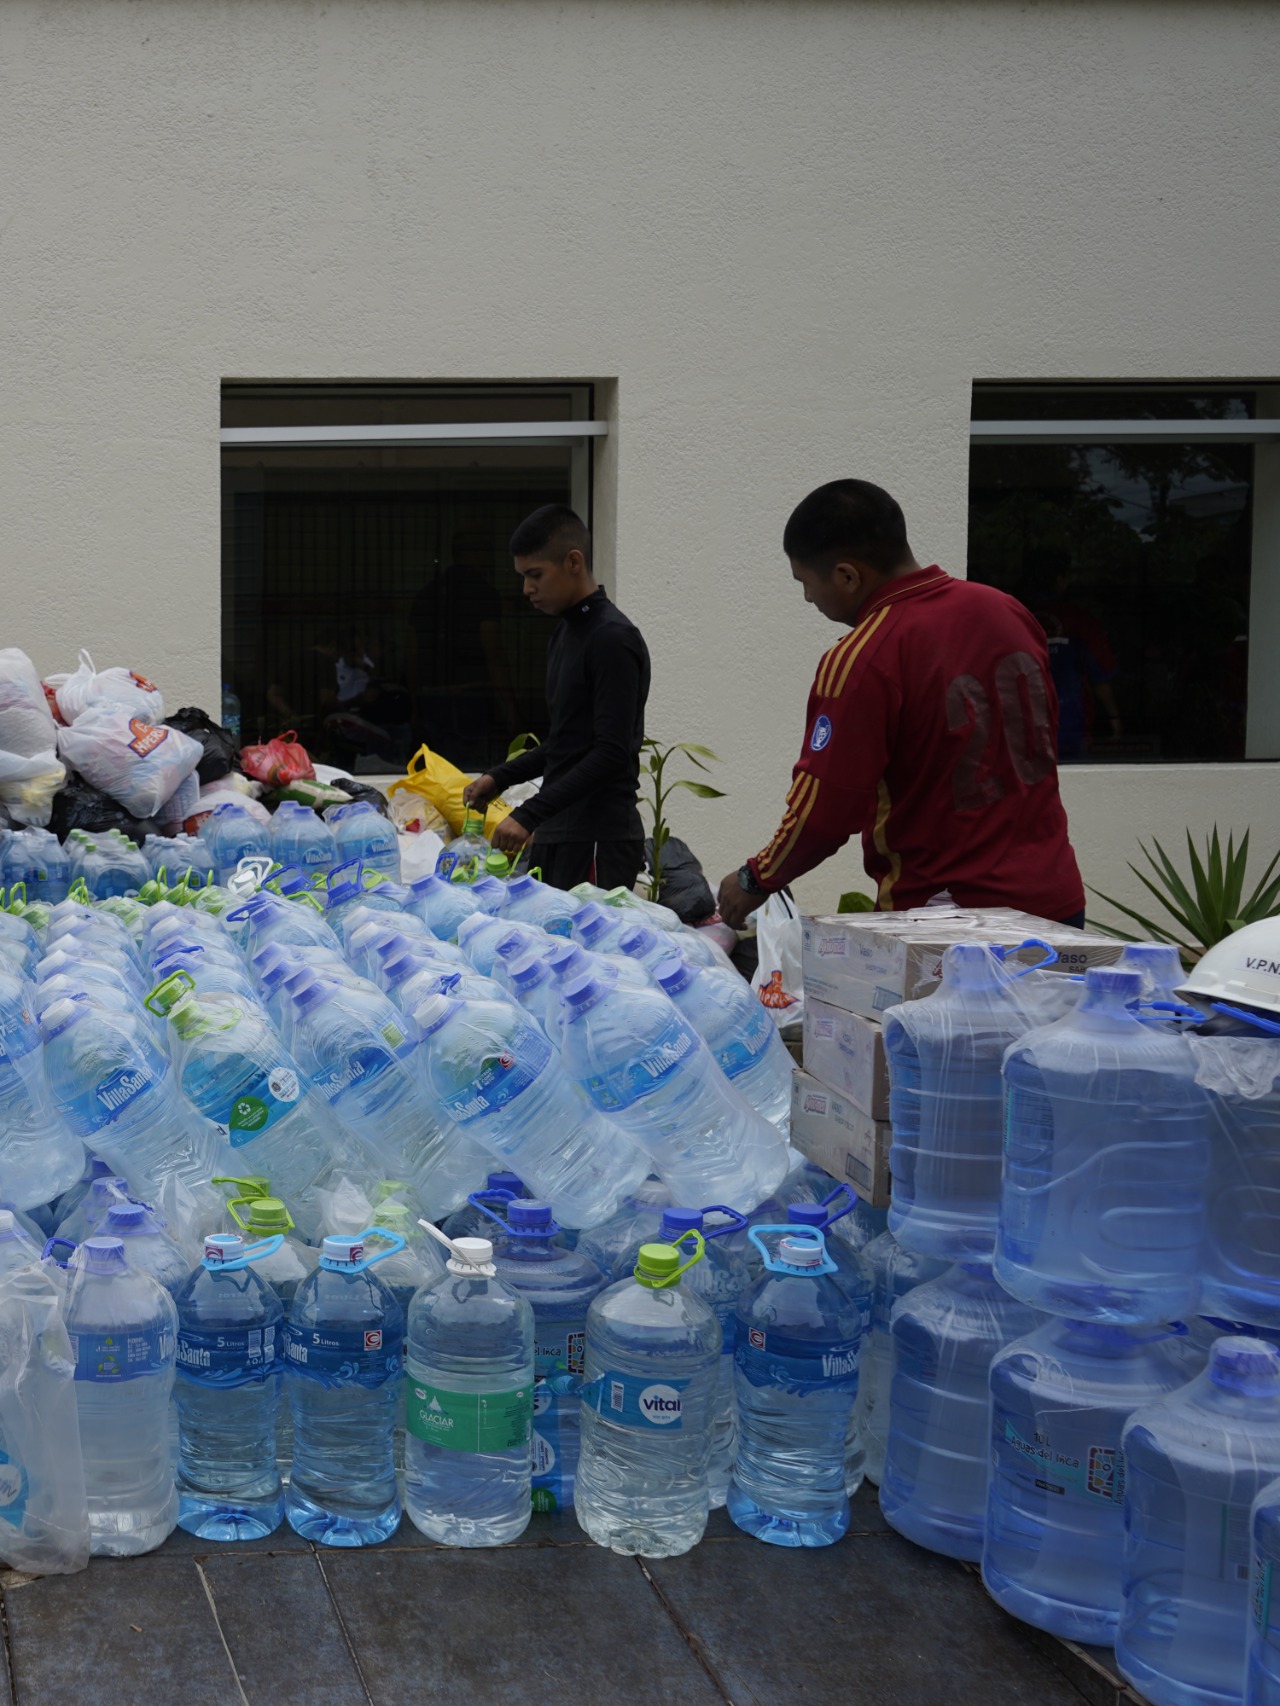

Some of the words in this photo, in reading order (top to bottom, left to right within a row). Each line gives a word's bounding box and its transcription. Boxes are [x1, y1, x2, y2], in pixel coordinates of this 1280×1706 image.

[946, 652, 1056, 812] 20
[640, 1032, 692, 1078] VillaSanta
[217, 1337, 225, 1347] 5
[312, 1333, 320, 1344] 5
[643, 1395, 681, 1412] vital
[420, 1410, 454, 1427] GLACIAR
[1011, 1436, 1035, 1456] Aguas
[1037, 1448, 1052, 1461] del
